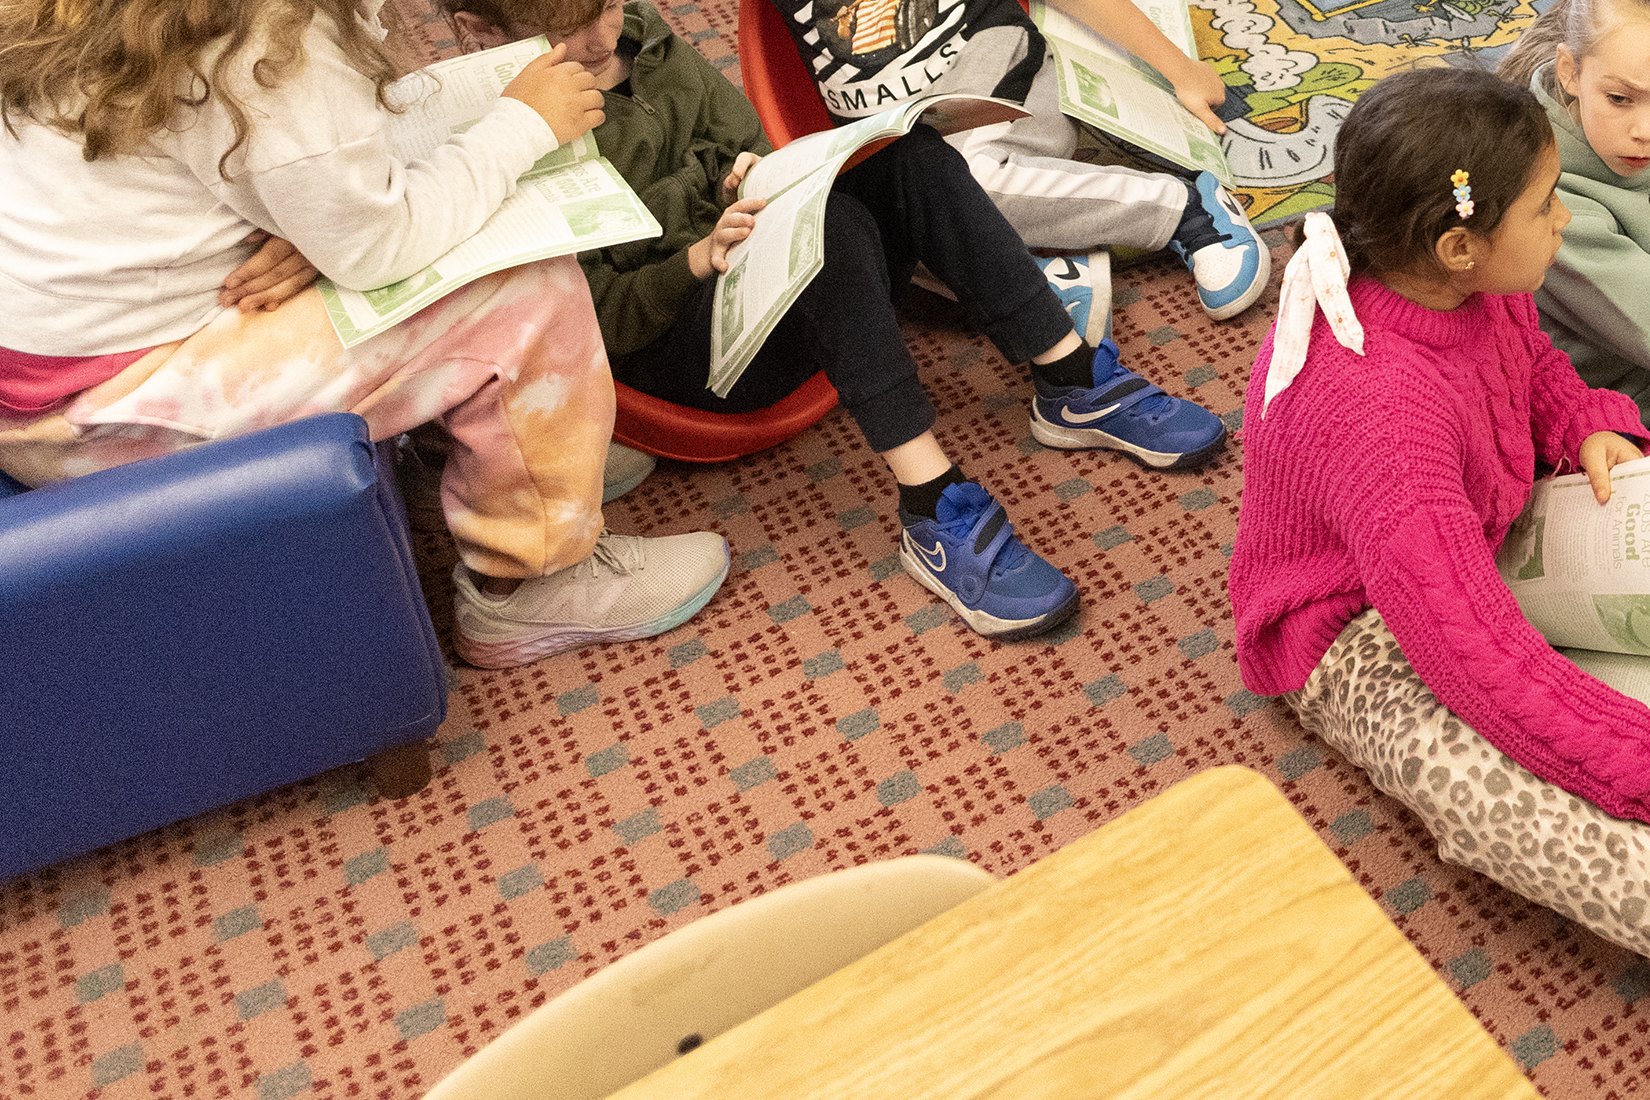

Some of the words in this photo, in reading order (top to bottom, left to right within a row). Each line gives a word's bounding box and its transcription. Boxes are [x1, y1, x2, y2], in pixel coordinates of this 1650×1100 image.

[827, 43, 959, 111] SMALLS
[1614, 496, 1627, 515] for
[1625, 503, 1641, 561] Good
[1612, 519, 1624, 570] Animals
